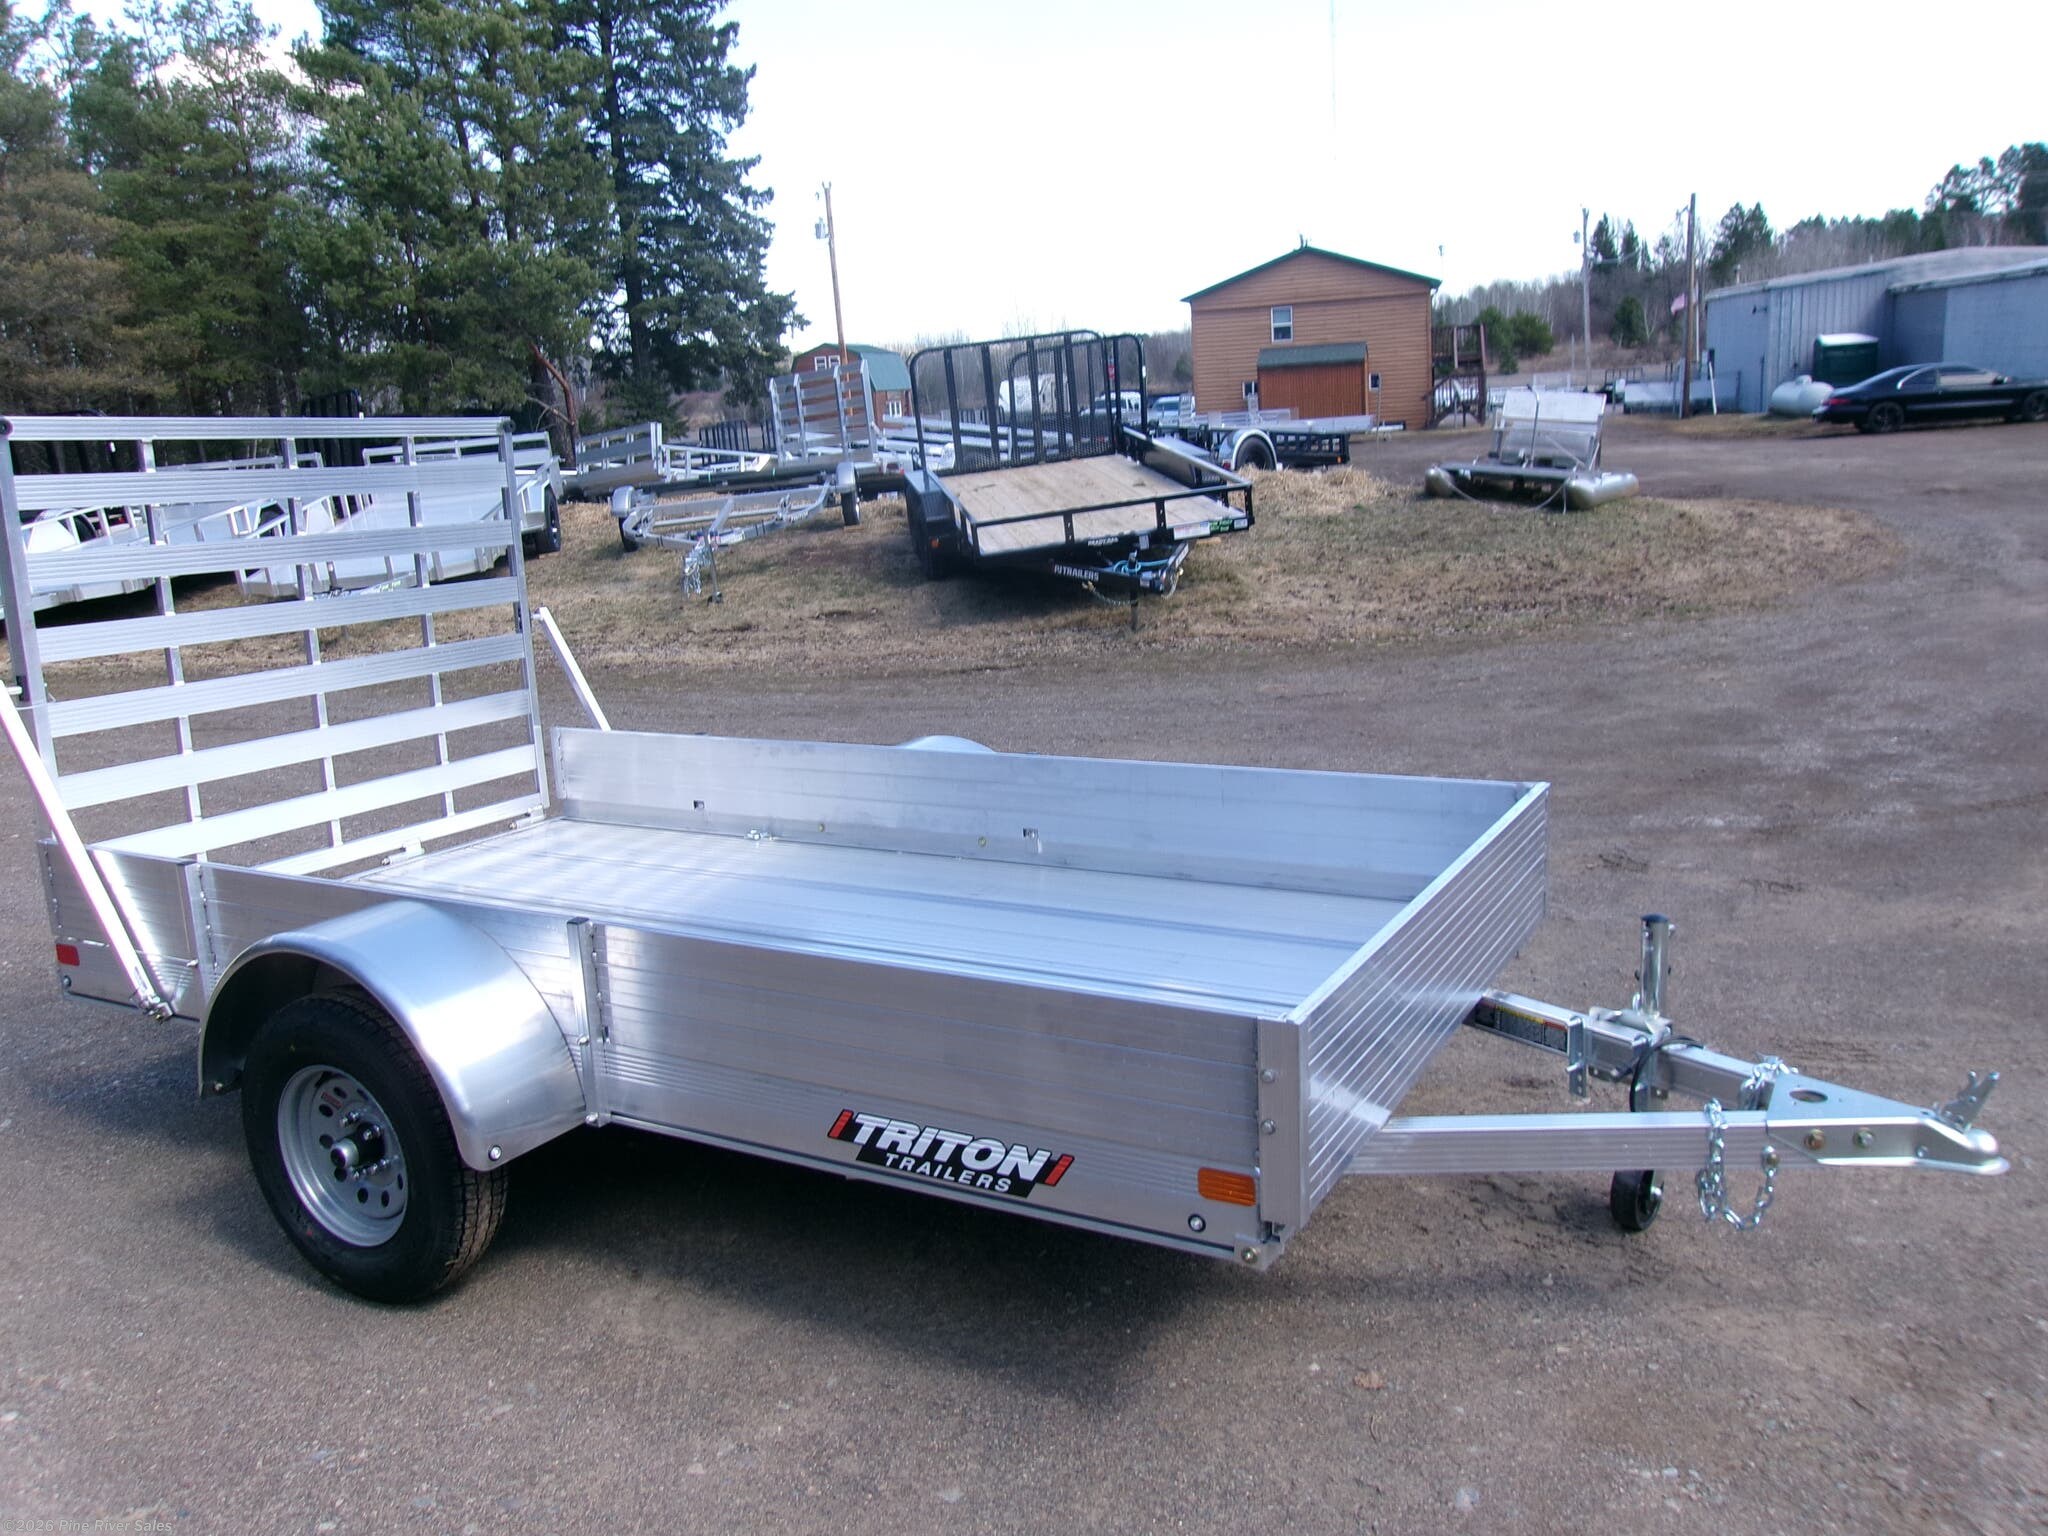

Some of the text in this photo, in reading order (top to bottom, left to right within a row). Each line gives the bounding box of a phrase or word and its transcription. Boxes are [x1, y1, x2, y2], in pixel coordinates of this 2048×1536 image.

[1063, 565, 1099, 582] TRAILERS
[853, 1113, 1051, 1181] TRITON
[886, 1153, 1012, 1192] TRAILERS
